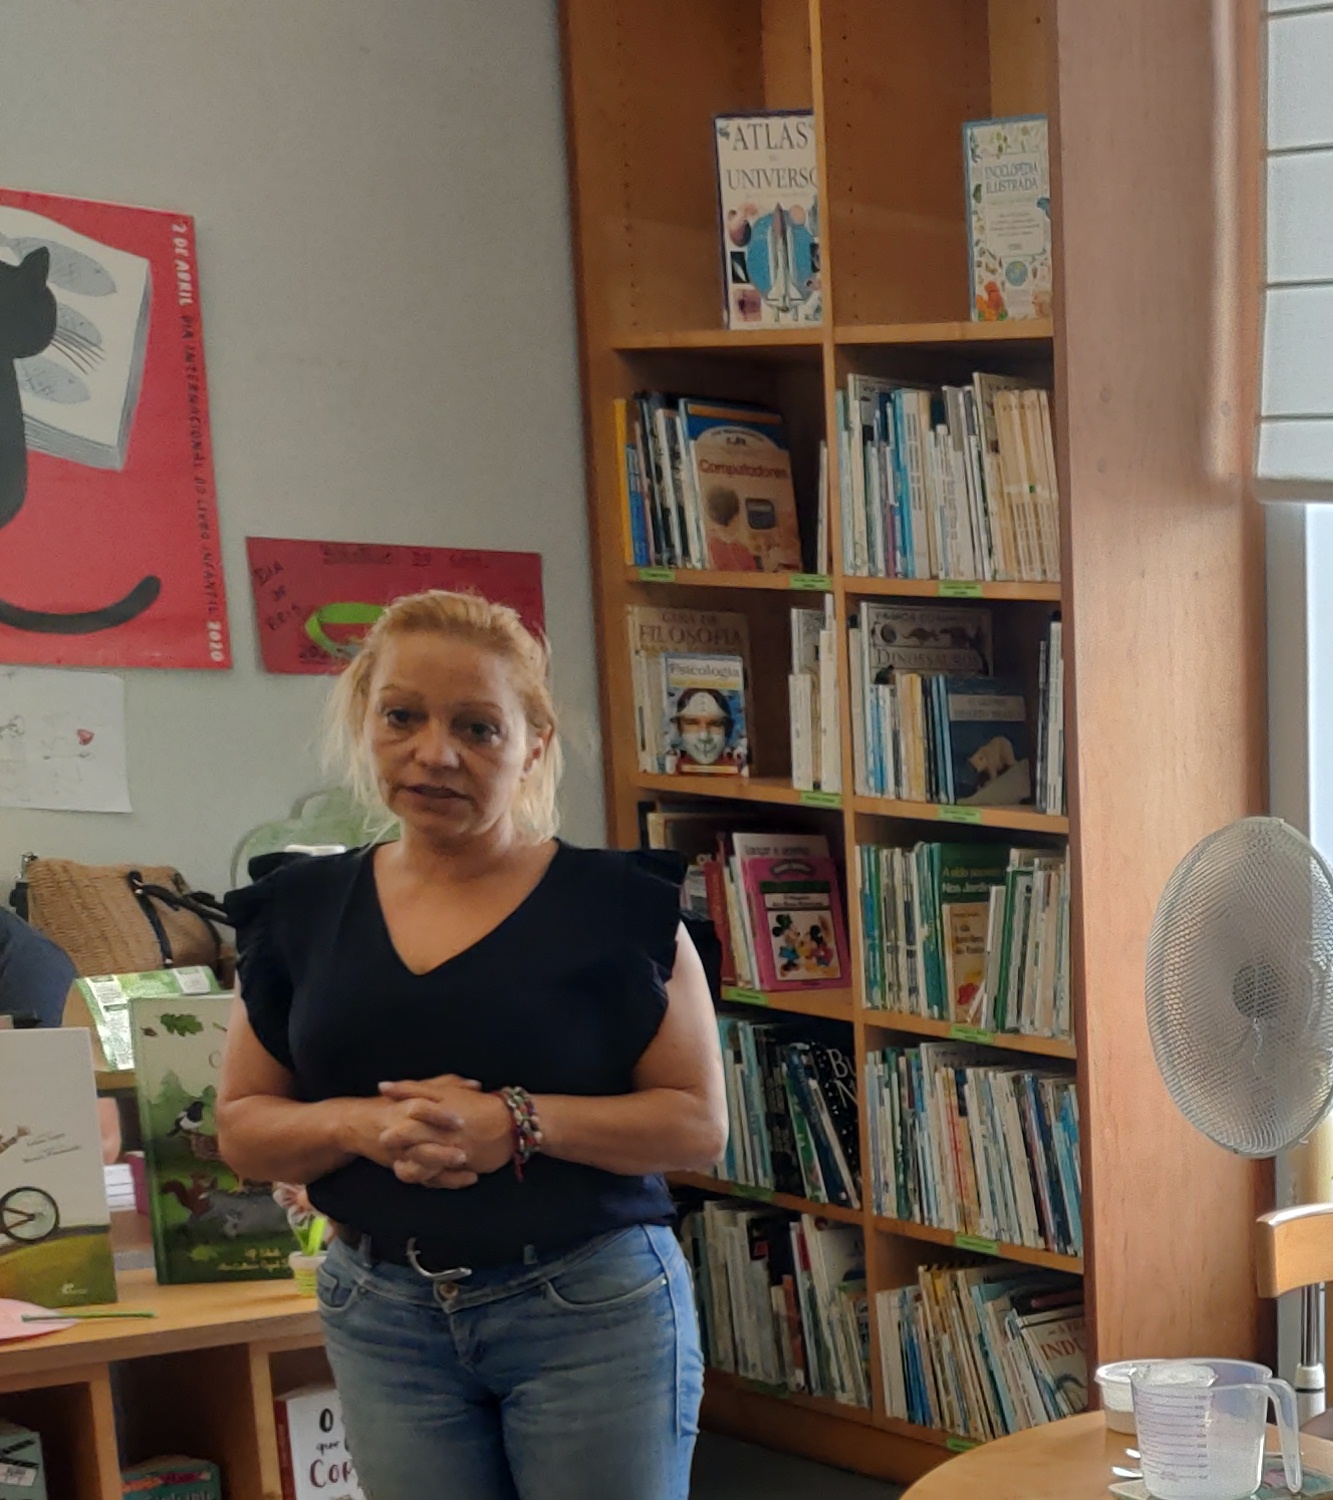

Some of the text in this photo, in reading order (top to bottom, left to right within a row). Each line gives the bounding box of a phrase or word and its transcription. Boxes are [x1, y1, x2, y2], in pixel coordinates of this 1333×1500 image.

[730, 121, 809, 152] ATLAS
[172, 222, 192, 306] 2 DE ABRIL
[207, 619, 224, 663] 2020
[640, 625, 741, 645] FILOSOFIA
[669, 663, 740, 678] Psicologia
